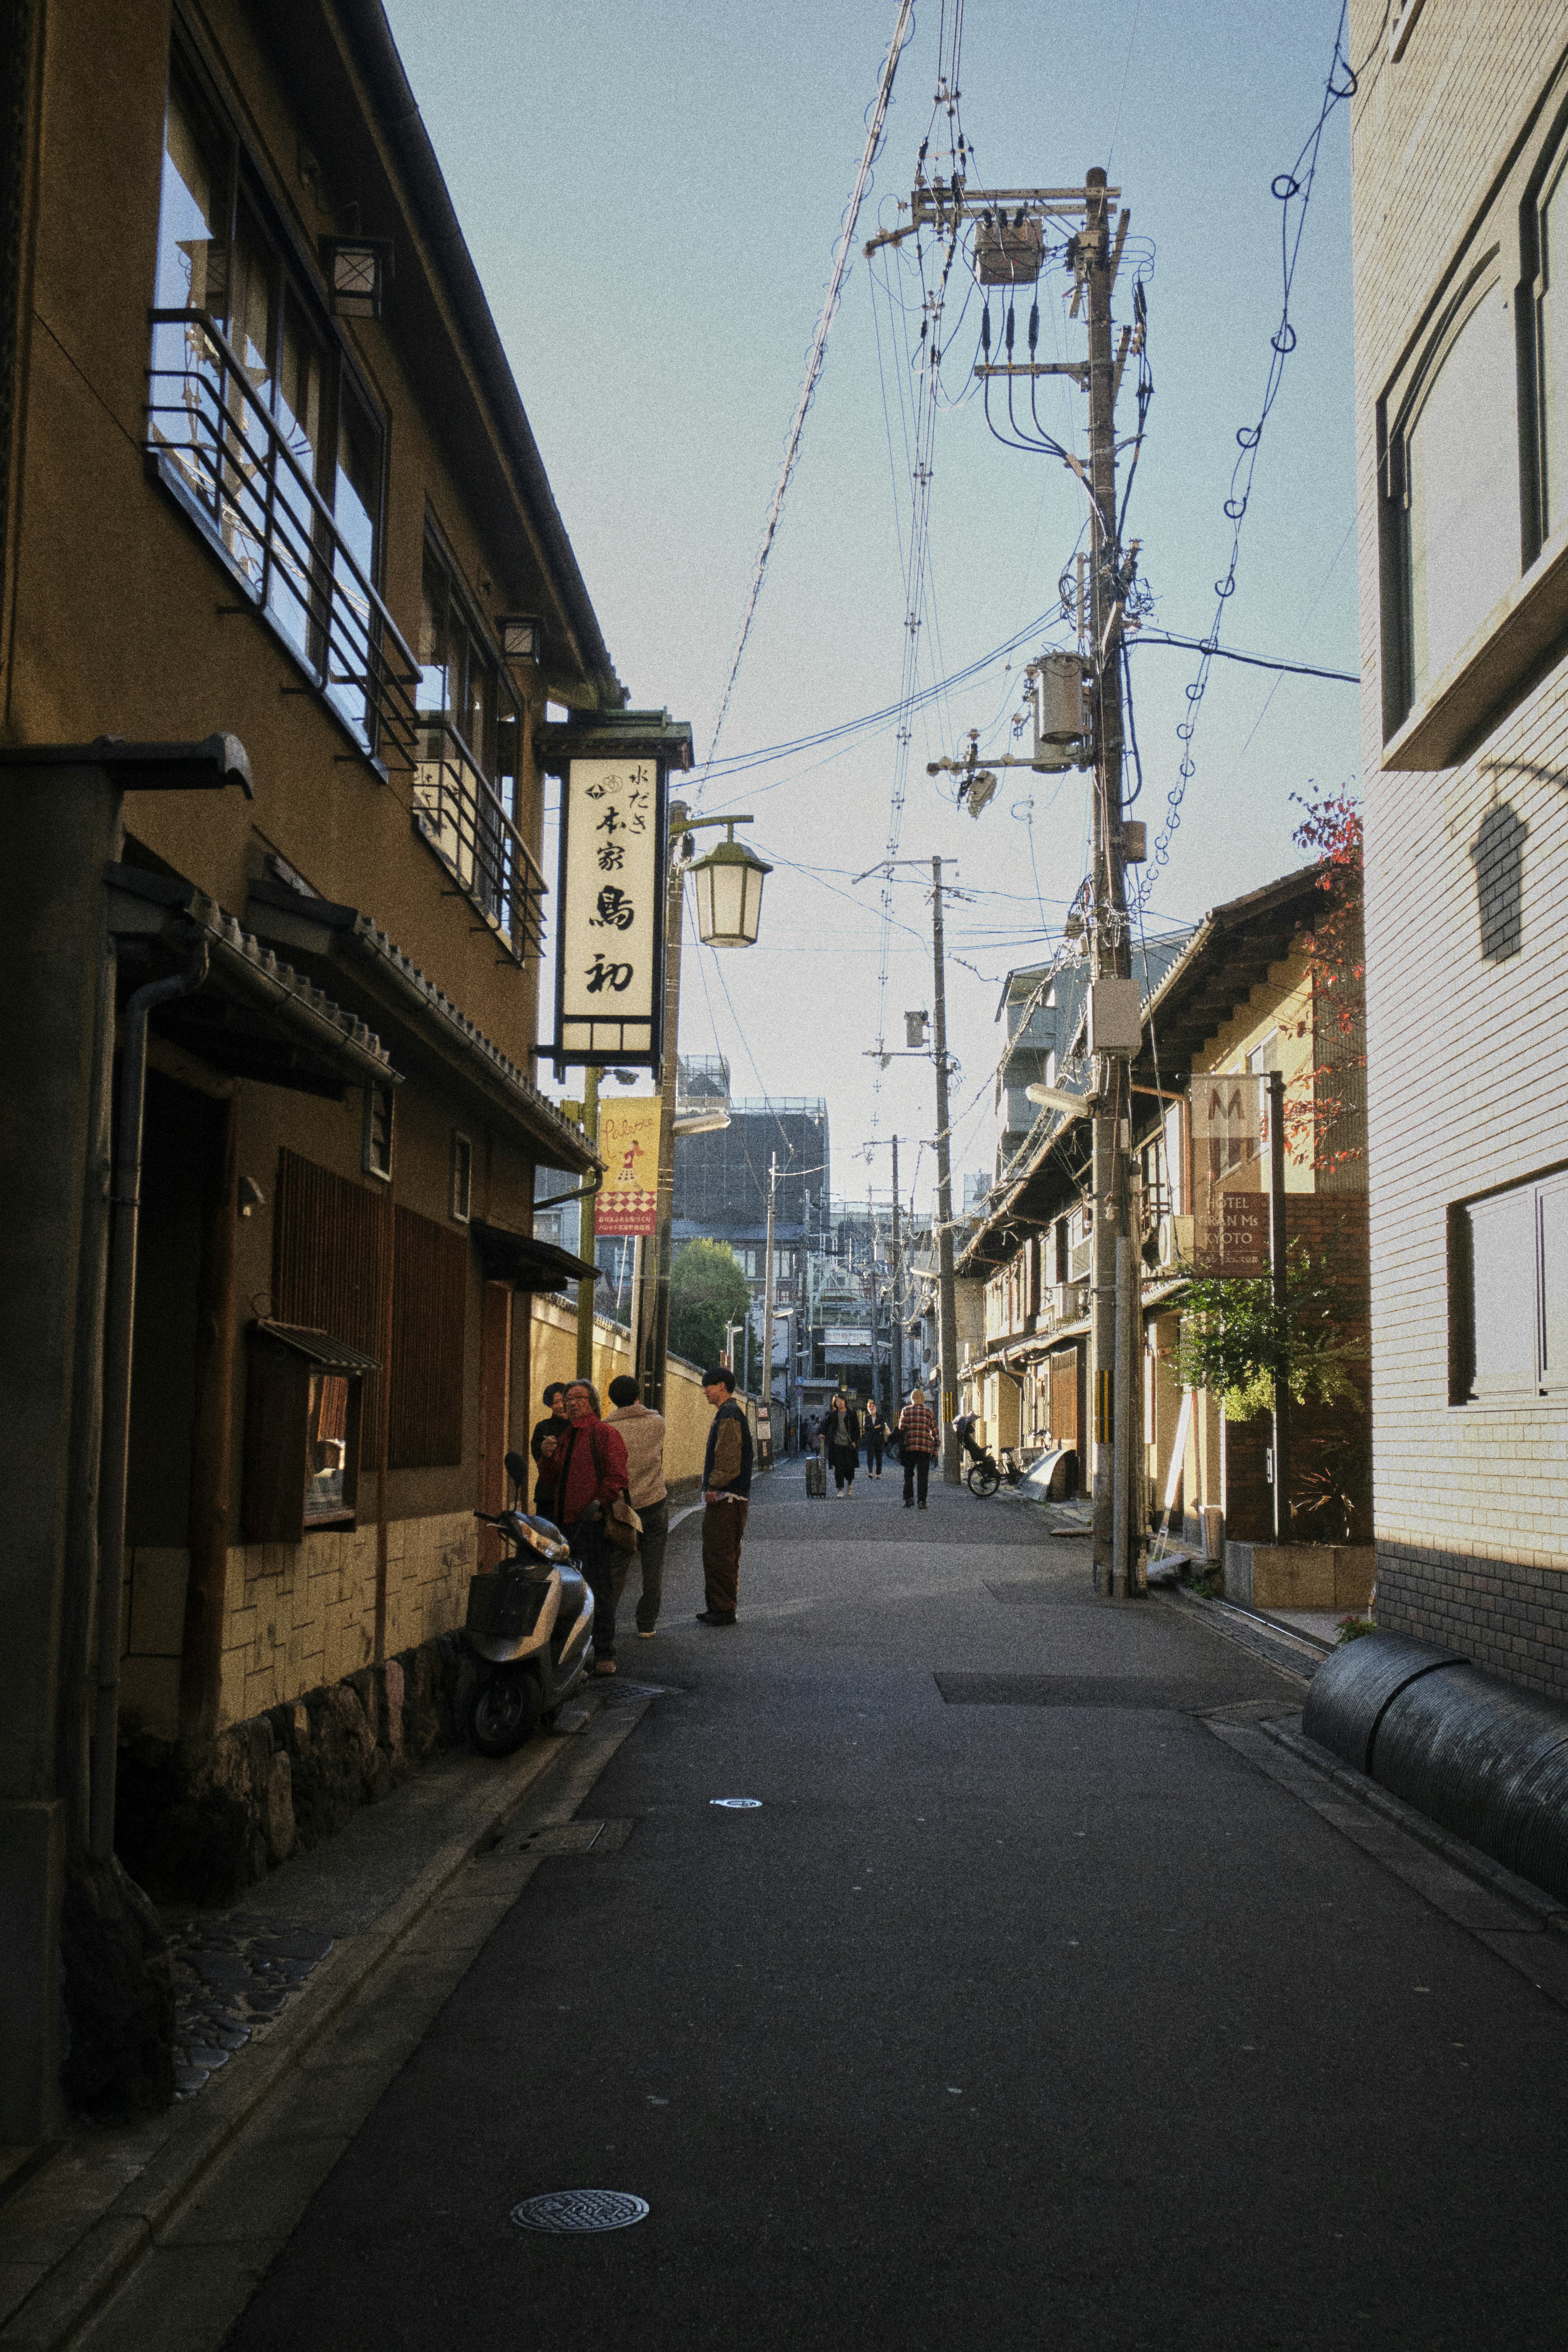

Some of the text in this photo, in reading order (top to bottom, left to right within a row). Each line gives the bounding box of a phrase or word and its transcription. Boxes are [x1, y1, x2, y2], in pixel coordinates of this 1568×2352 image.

[629, 765, 650, 834] 水だき
[1208, 1088, 1245, 1120] M
[1206, 1197, 1249, 1208] HOTEL
[1197, 1215, 1258, 1226] GRAN Ms
[1205, 1233, 1253, 1244] KYOTO
